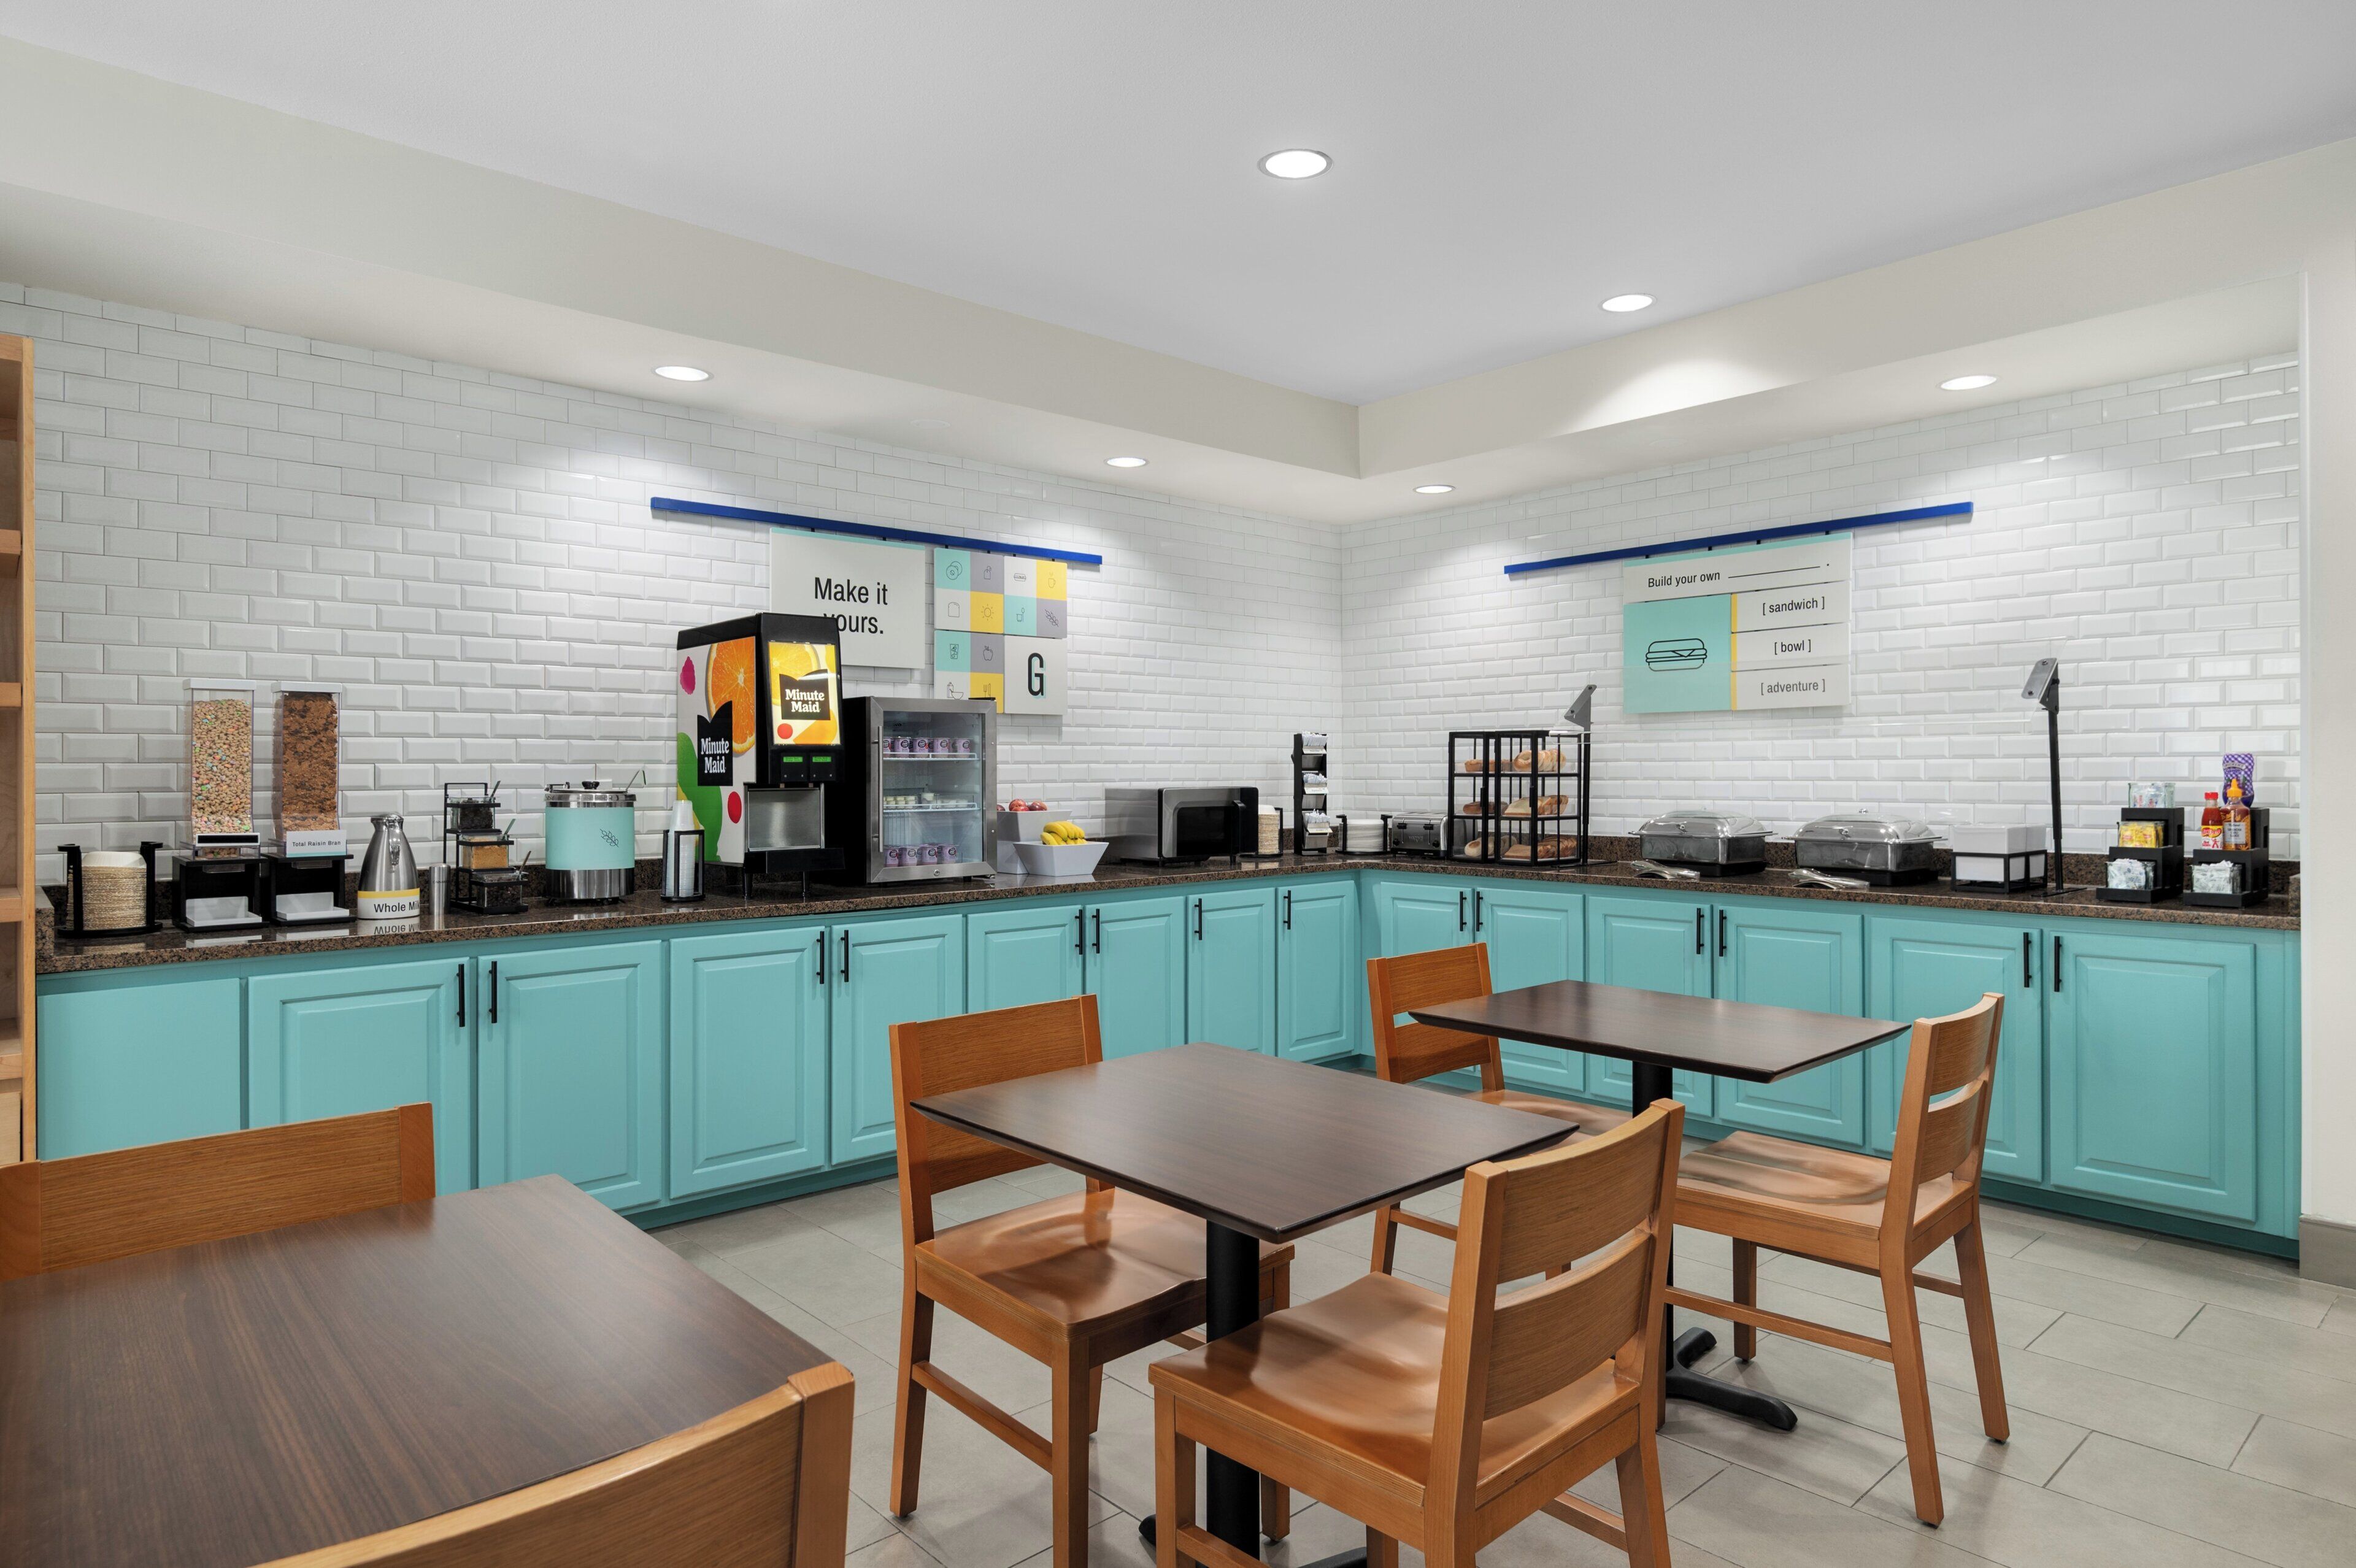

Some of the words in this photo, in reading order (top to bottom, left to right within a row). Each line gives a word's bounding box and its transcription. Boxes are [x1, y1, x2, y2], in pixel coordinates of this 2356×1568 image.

[1648, 575, 1673, 588] Build
[1675, 575, 1697, 587] your
[1700, 572, 1720, 582] own
[815, 577, 869, 604] Make
[877, 582, 888, 605] it
[1769, 598, 1818, 613] sandwich
[823, 613, 884, 634] ours.
[1780, 640, 1804, 653] bowl
[1028, 652, 1044, 696] G
[785, 688, 825, 701] Minute
[1767, 681, 1819, 693] adventure
[791, 701, 820, 713] Maid
[701, 737, 730, 755] Minute
[704, 755, 726, 774] Maid
[374, 902, 406, 913] Whole
